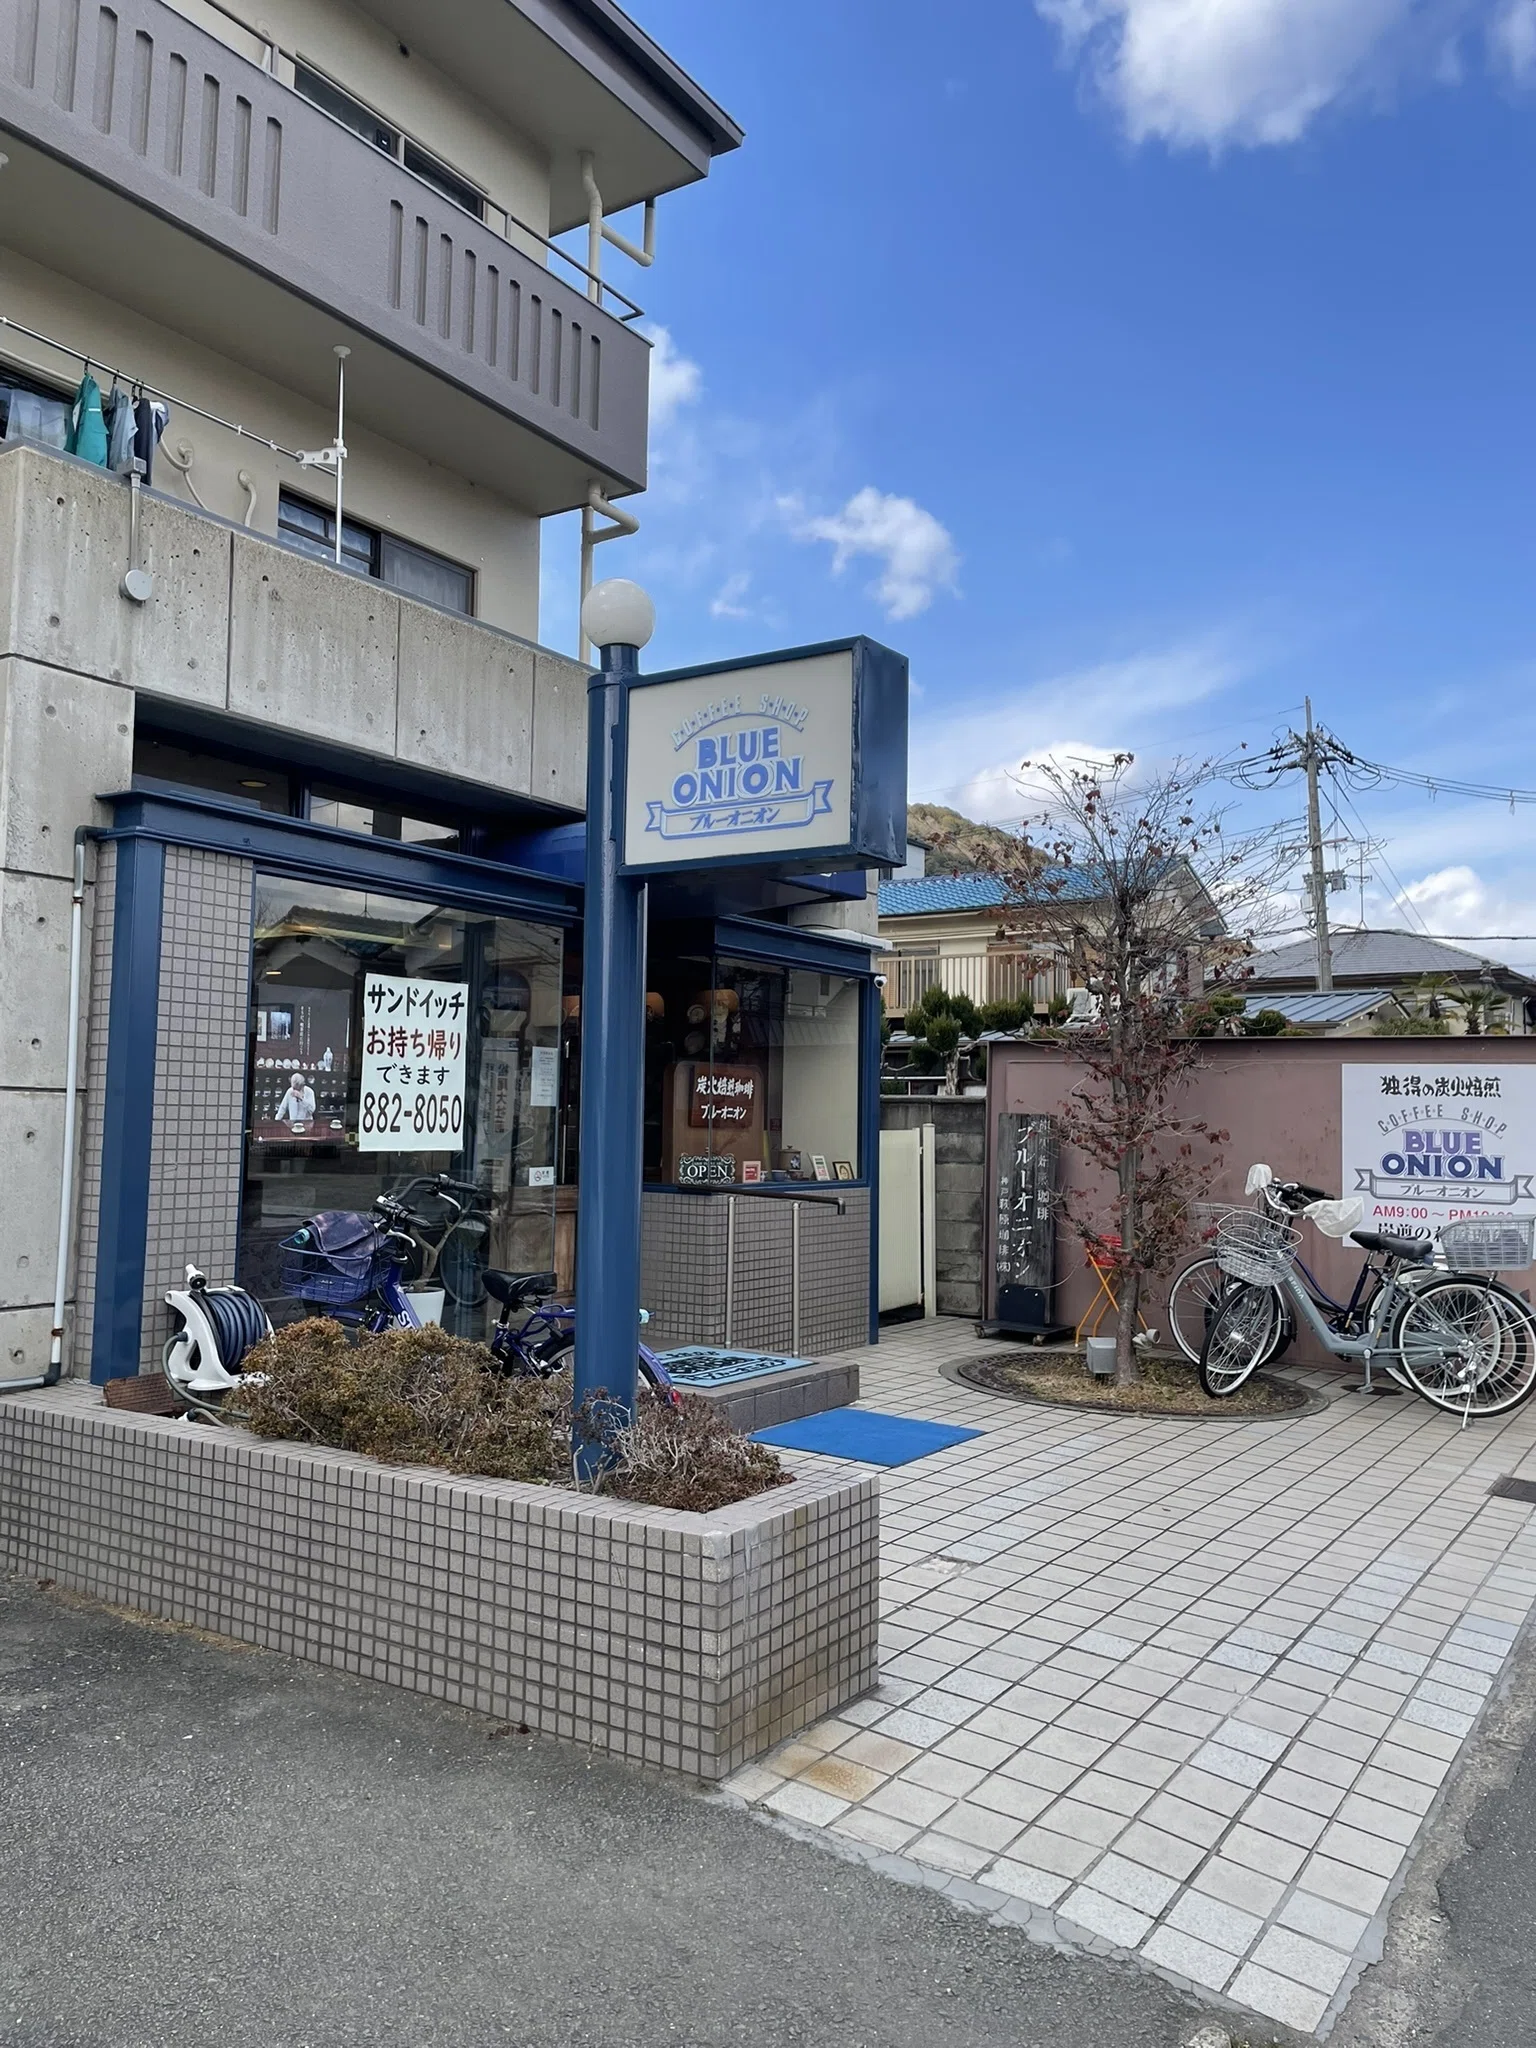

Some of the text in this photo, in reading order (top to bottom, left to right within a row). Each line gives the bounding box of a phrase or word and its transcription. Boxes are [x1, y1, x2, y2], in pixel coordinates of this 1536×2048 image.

[696, 725, 780, 770] BLUE
[672, 756, 804, 807] ONION
[689, 807, 780, 831] ブルーオニオン
[367, 983, 465, 1020] サンドイッチ
[366, 1024, 462, 1061] お持ち帰り
[376, 1062, 451, 1087] できます
[362, 1091, 462, 1134] 882-8050
[701, 1104, 747, 1120] ブルーオニオン
[1402, 1129, 1482, 1155] BLUE
[687, 1165, 728, 1178] OPEN
[1380, 1151, 1505, 1180] ONION
[1011, 1121, 1036, 1280] ブルーオニオン
[1400, 1184, 1485, 1199] ブルーオニオン
[1373, 1205, 1428, 1219] AM9:00
